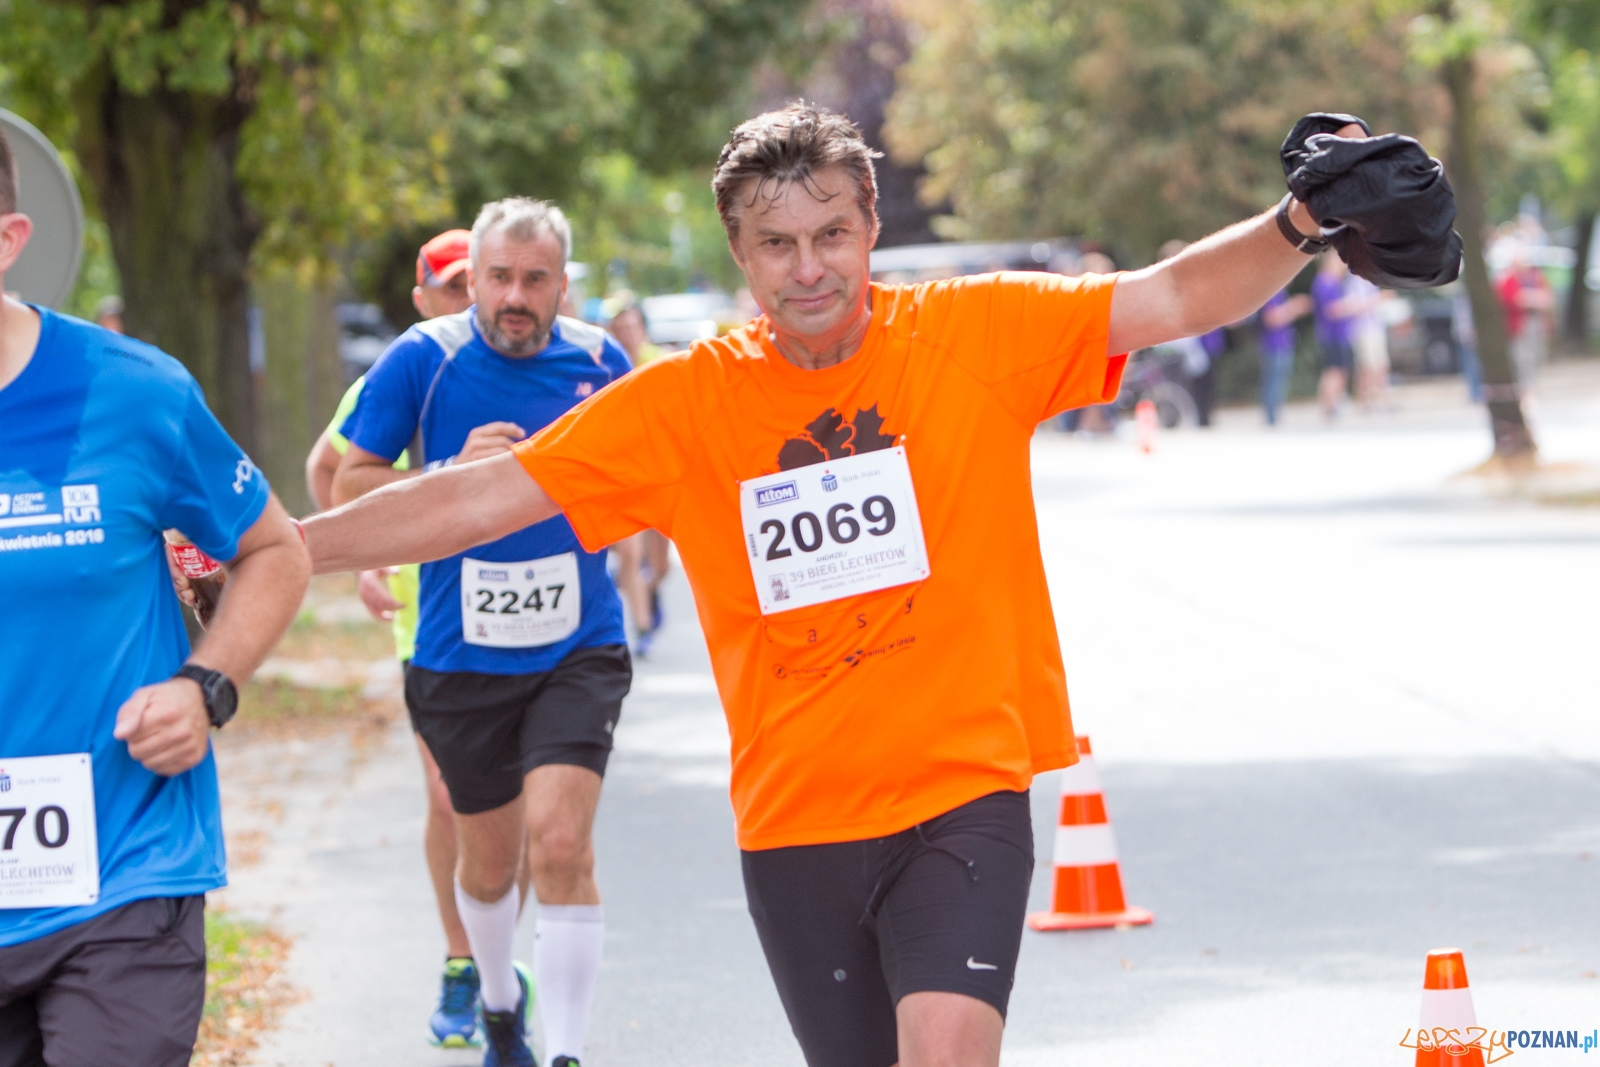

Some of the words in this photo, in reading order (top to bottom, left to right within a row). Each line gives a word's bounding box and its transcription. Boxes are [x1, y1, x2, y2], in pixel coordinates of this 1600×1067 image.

[63, 506, 101, 524] run
[759, 495, 896, 562] 2069
[789, 571, 805, 583] 39
[807, 562, 838, 579] BIEG
[840, 545, 907, 571] LECHITÓW
[476, 582, 565, 614] 2247
